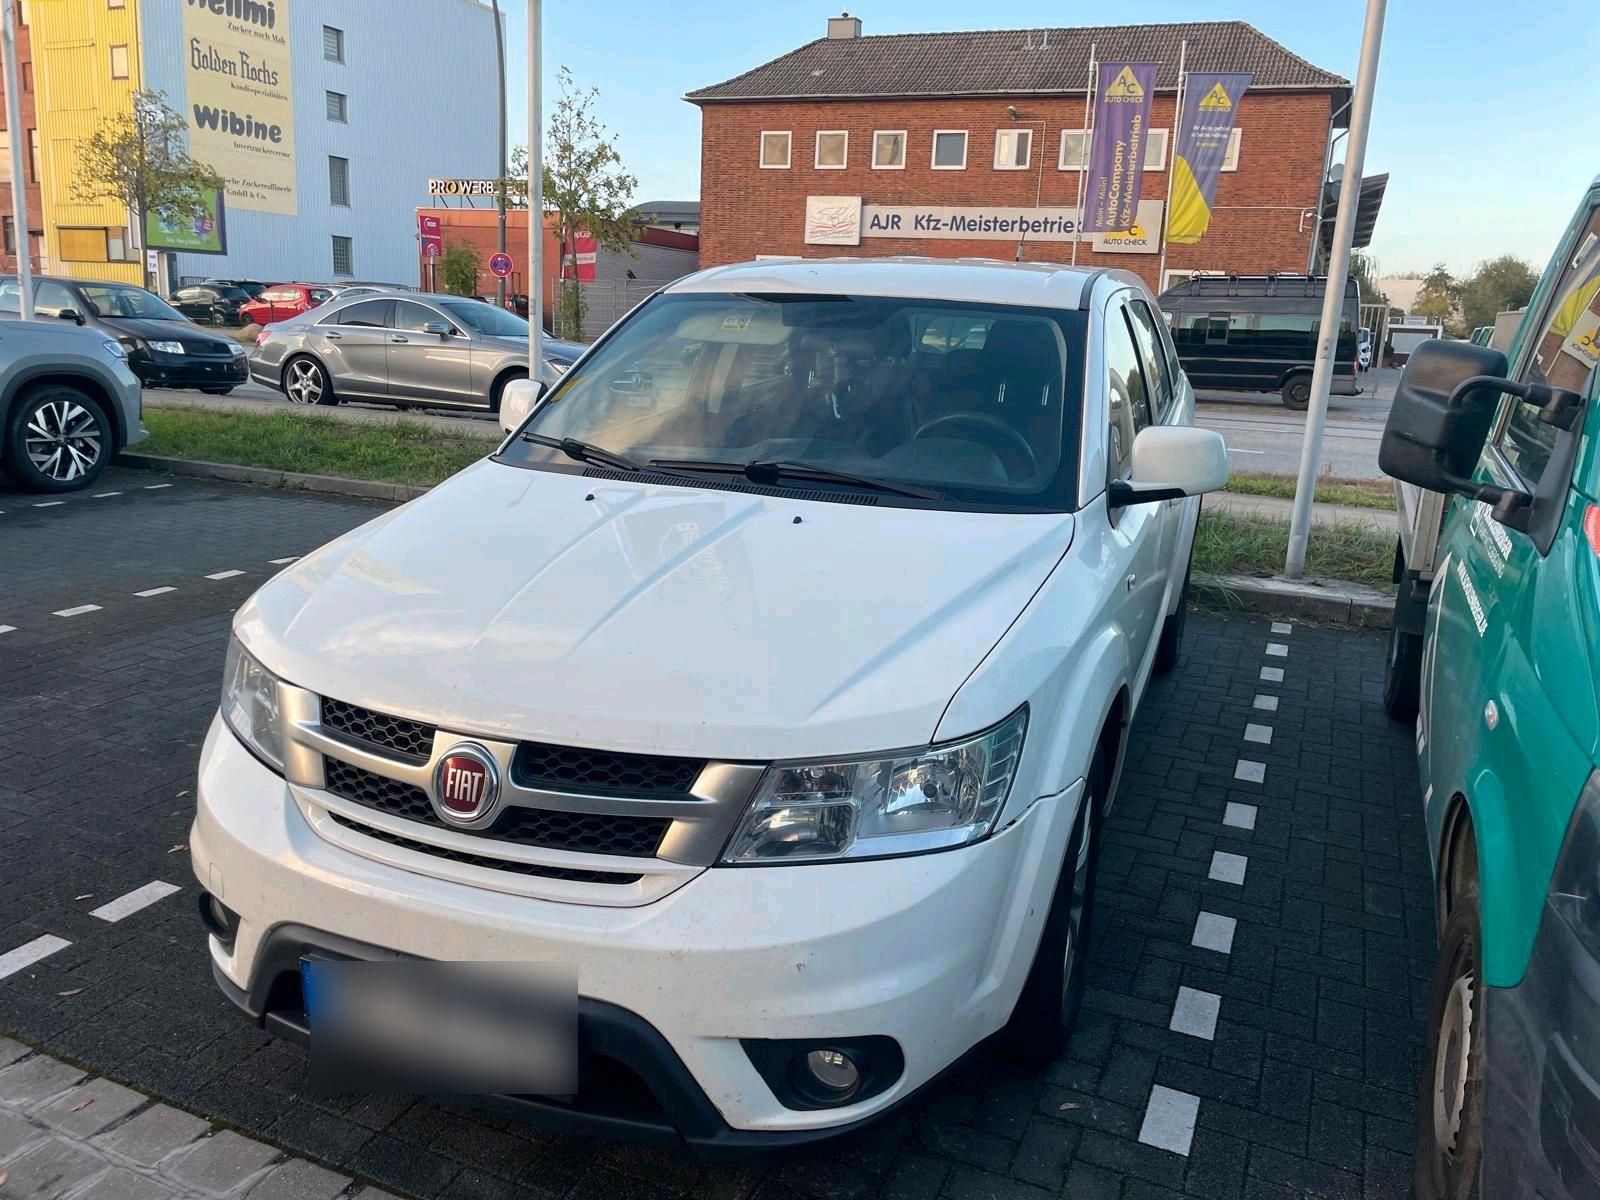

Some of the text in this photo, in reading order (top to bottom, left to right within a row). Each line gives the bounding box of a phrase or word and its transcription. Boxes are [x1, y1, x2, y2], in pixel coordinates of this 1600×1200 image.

[193, 104, 282, 143] Wibine
[1106, 140, 1127, 227] AutoCompany
[1120, 114, 1142, 227] Kfz-Meisterbetrieb
[870, 213, 1081, 233] AJR Kfz-Meisterbetrie
[1095, 207, 1105, 227] Moin
[1103, 238, 1123, 246] AUTO
[446, 767, 483, 803] FIAT
